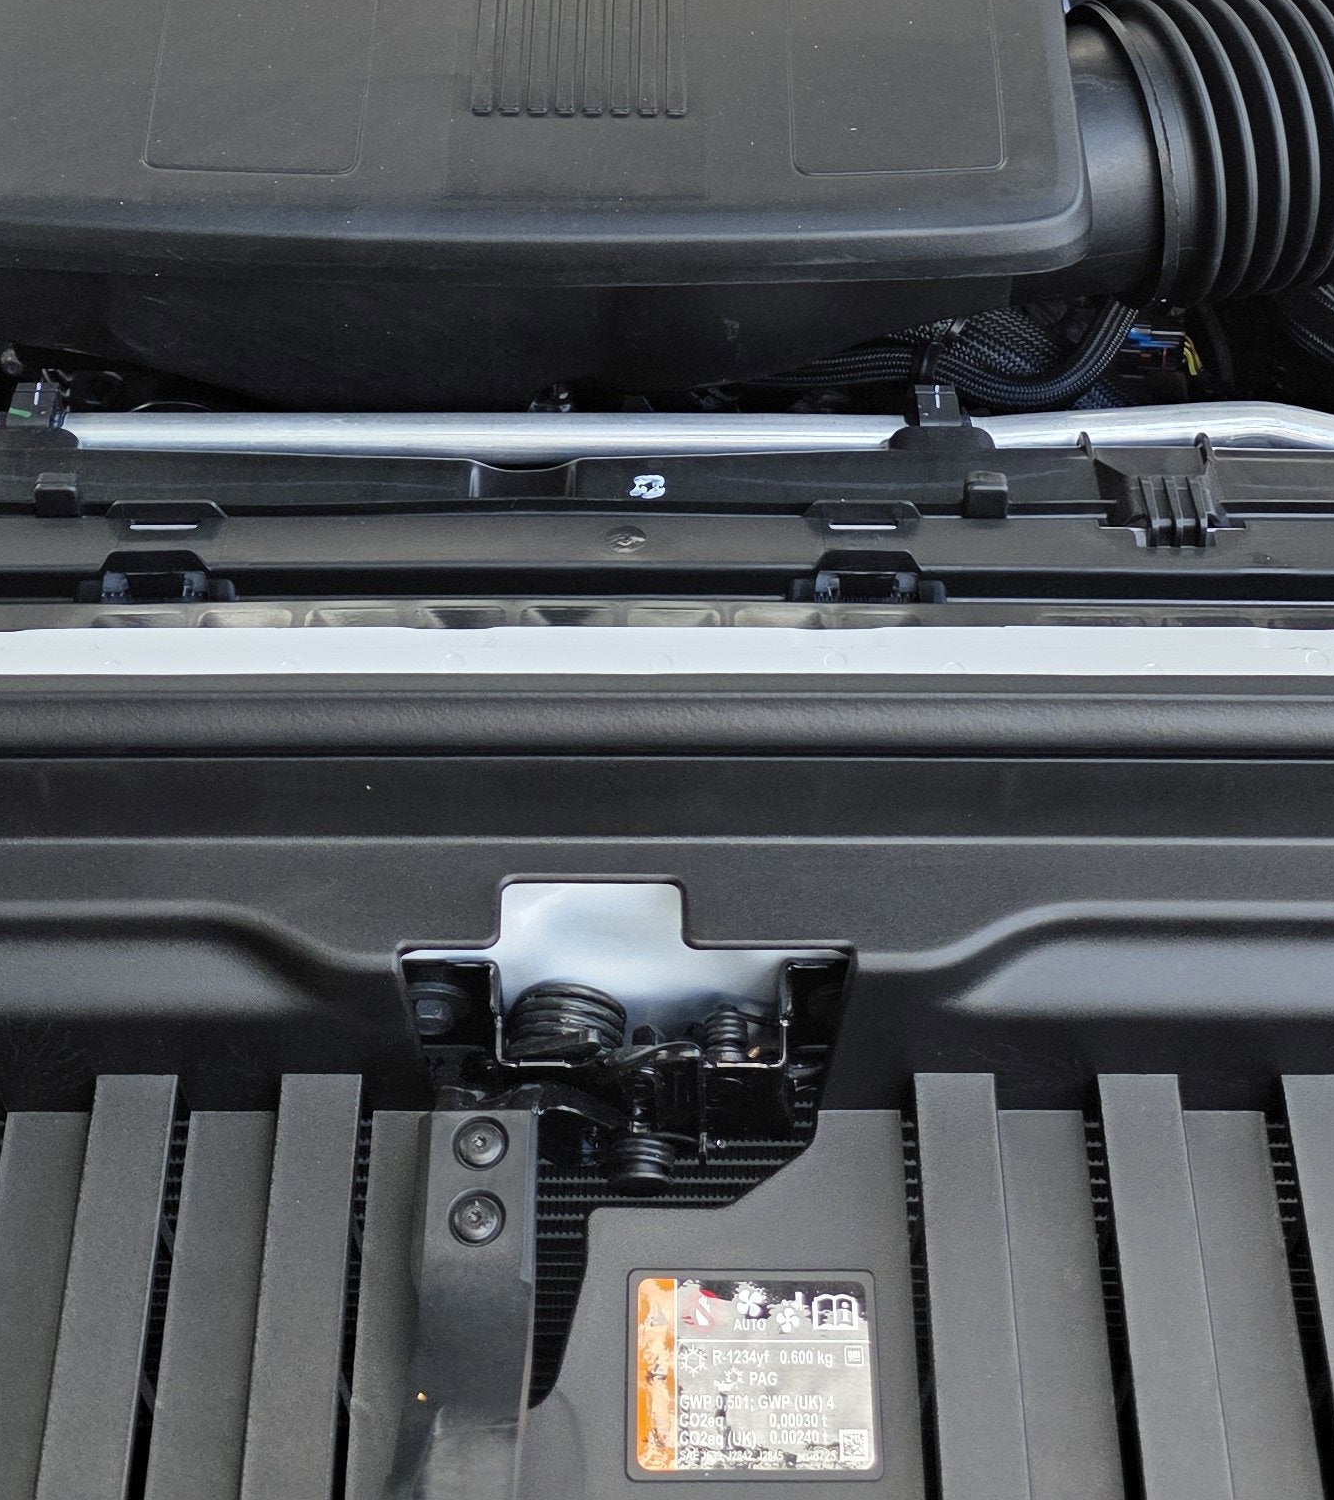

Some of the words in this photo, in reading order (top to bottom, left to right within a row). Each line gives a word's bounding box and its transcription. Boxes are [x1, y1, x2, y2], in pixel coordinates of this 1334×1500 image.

[734, 1318, 767, 1331] AUTO
[712, 1350, 770, 1367] R-1234yf
[779, 1350, 814, 1365] 0.600
[817, 1350, 833, 1367] kg
[749, 1371, 778, 1386] PAG
[679, 1394, 712, 1410] GWP
[757, 1394, 791, 1410] GWP
[794, 1394, 823, 1412] (UK)
[826, 1394, 835, 1410] 4
[679, 1413, 724, 1430] CO2eq
[821, 1413, 828, 1428] t
[679, 1430, 724, 1448] CO2eq
[727, 1430, 757, 1450] (UK)
